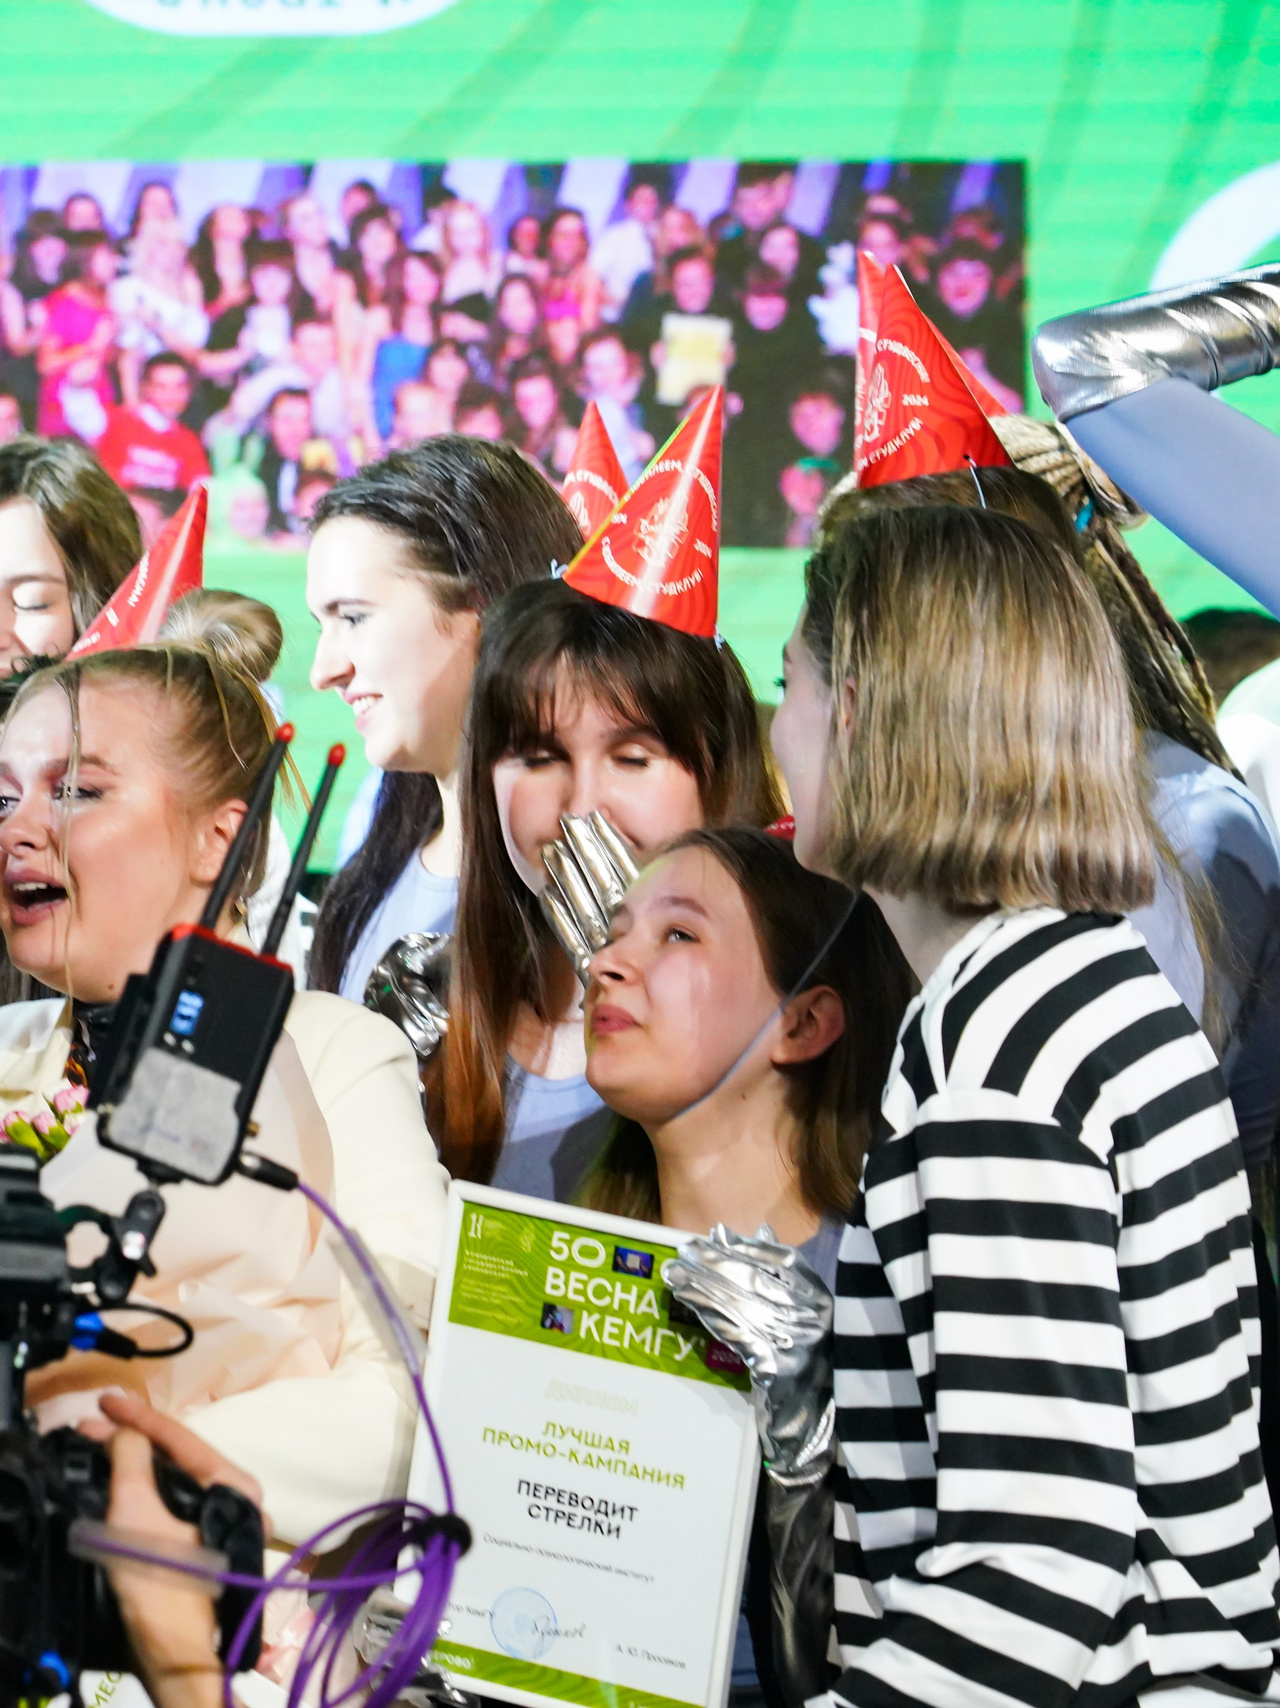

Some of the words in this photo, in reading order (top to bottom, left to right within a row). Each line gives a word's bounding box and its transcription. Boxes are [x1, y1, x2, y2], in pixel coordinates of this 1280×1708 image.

[902, 394, 930, 407] 2024
[549, 1230, 607, 1268] 50
[545, 1266, 660, 1320] ВЕСНА
[542, 1420, 631, 1455] ЛУЧШАЯ
[482, 1426, 686, 1490] ПРОМО-КАМПАНИЯ
[517, 1478, 639, 1523] ПЕРЕВОДИТ
[527, 1504, 622, 1540] СТРЕЛКИ
